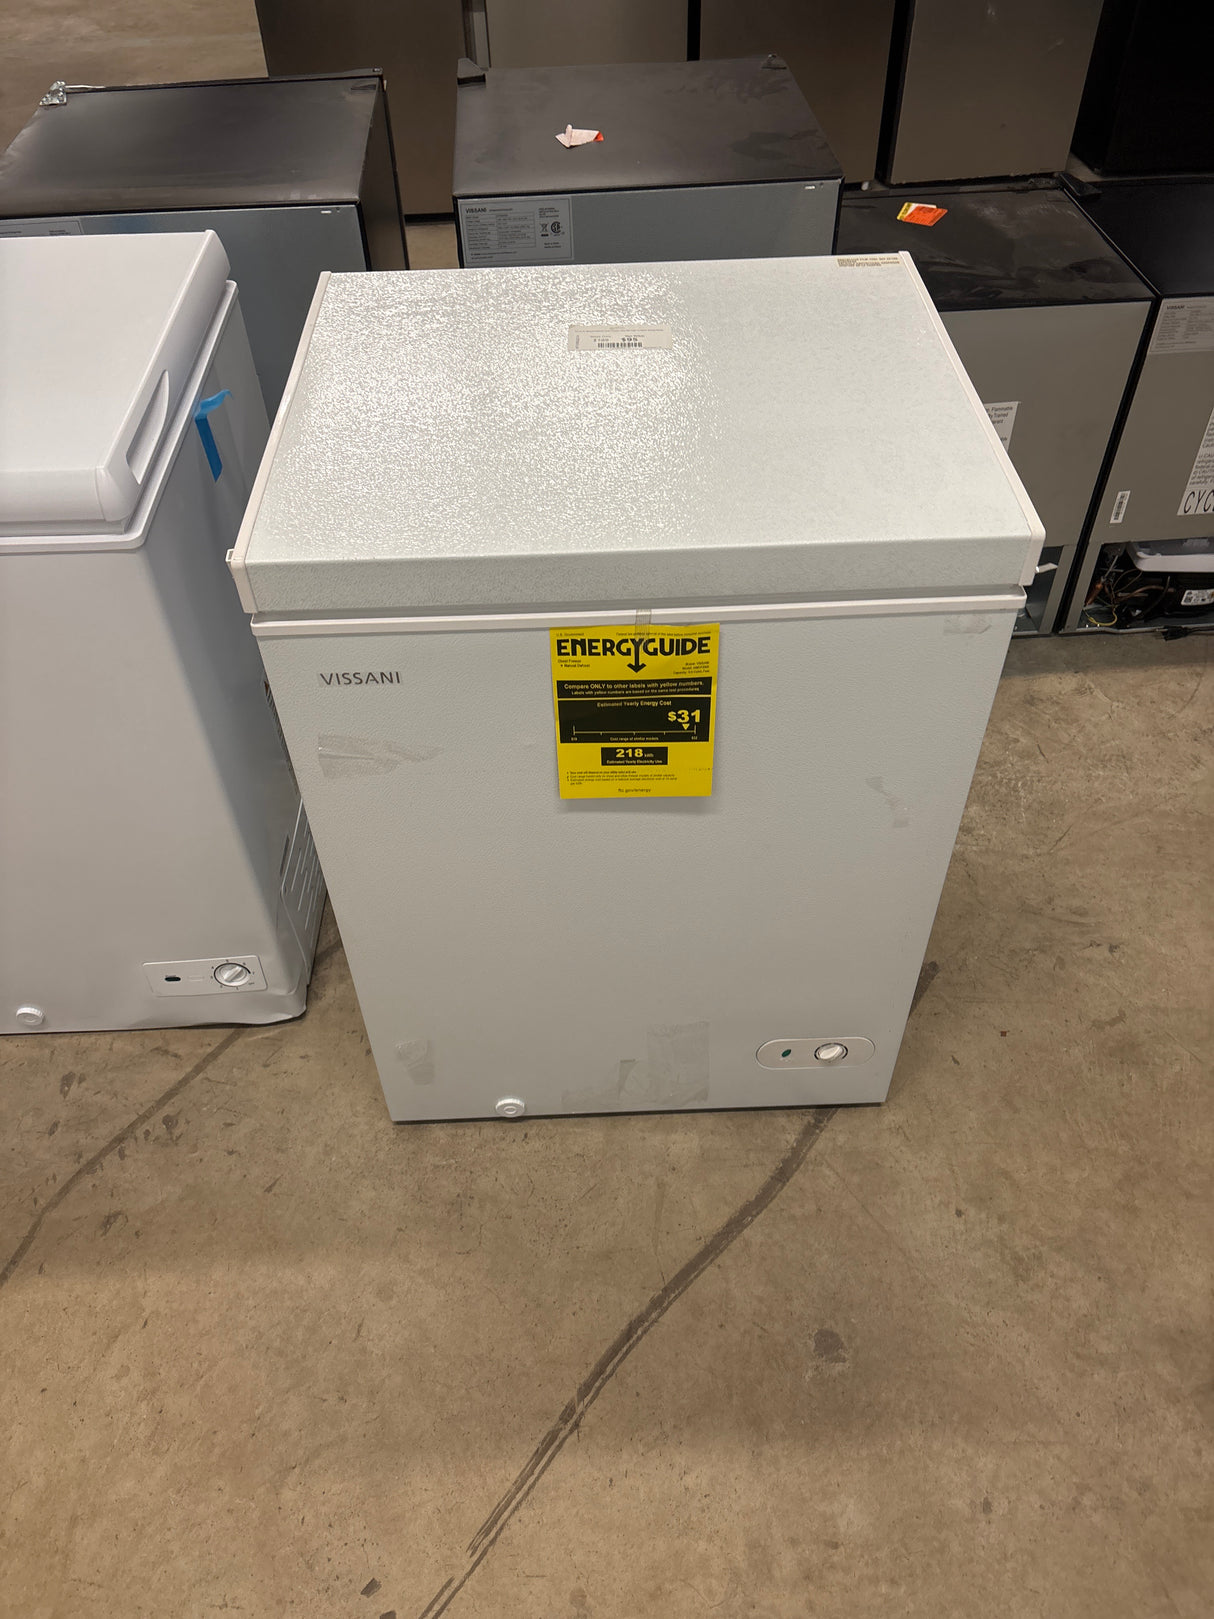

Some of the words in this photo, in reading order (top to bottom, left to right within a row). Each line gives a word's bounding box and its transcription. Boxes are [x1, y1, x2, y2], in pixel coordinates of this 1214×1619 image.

[1184, 490, 1214, 514] CYC
[557, 636, 711, 656] ENERGYGUIDE
[319, 671, 401, 686] VISSANI
[668, 709, 700, 723] $31
[616, 749, 643, 758] 218
